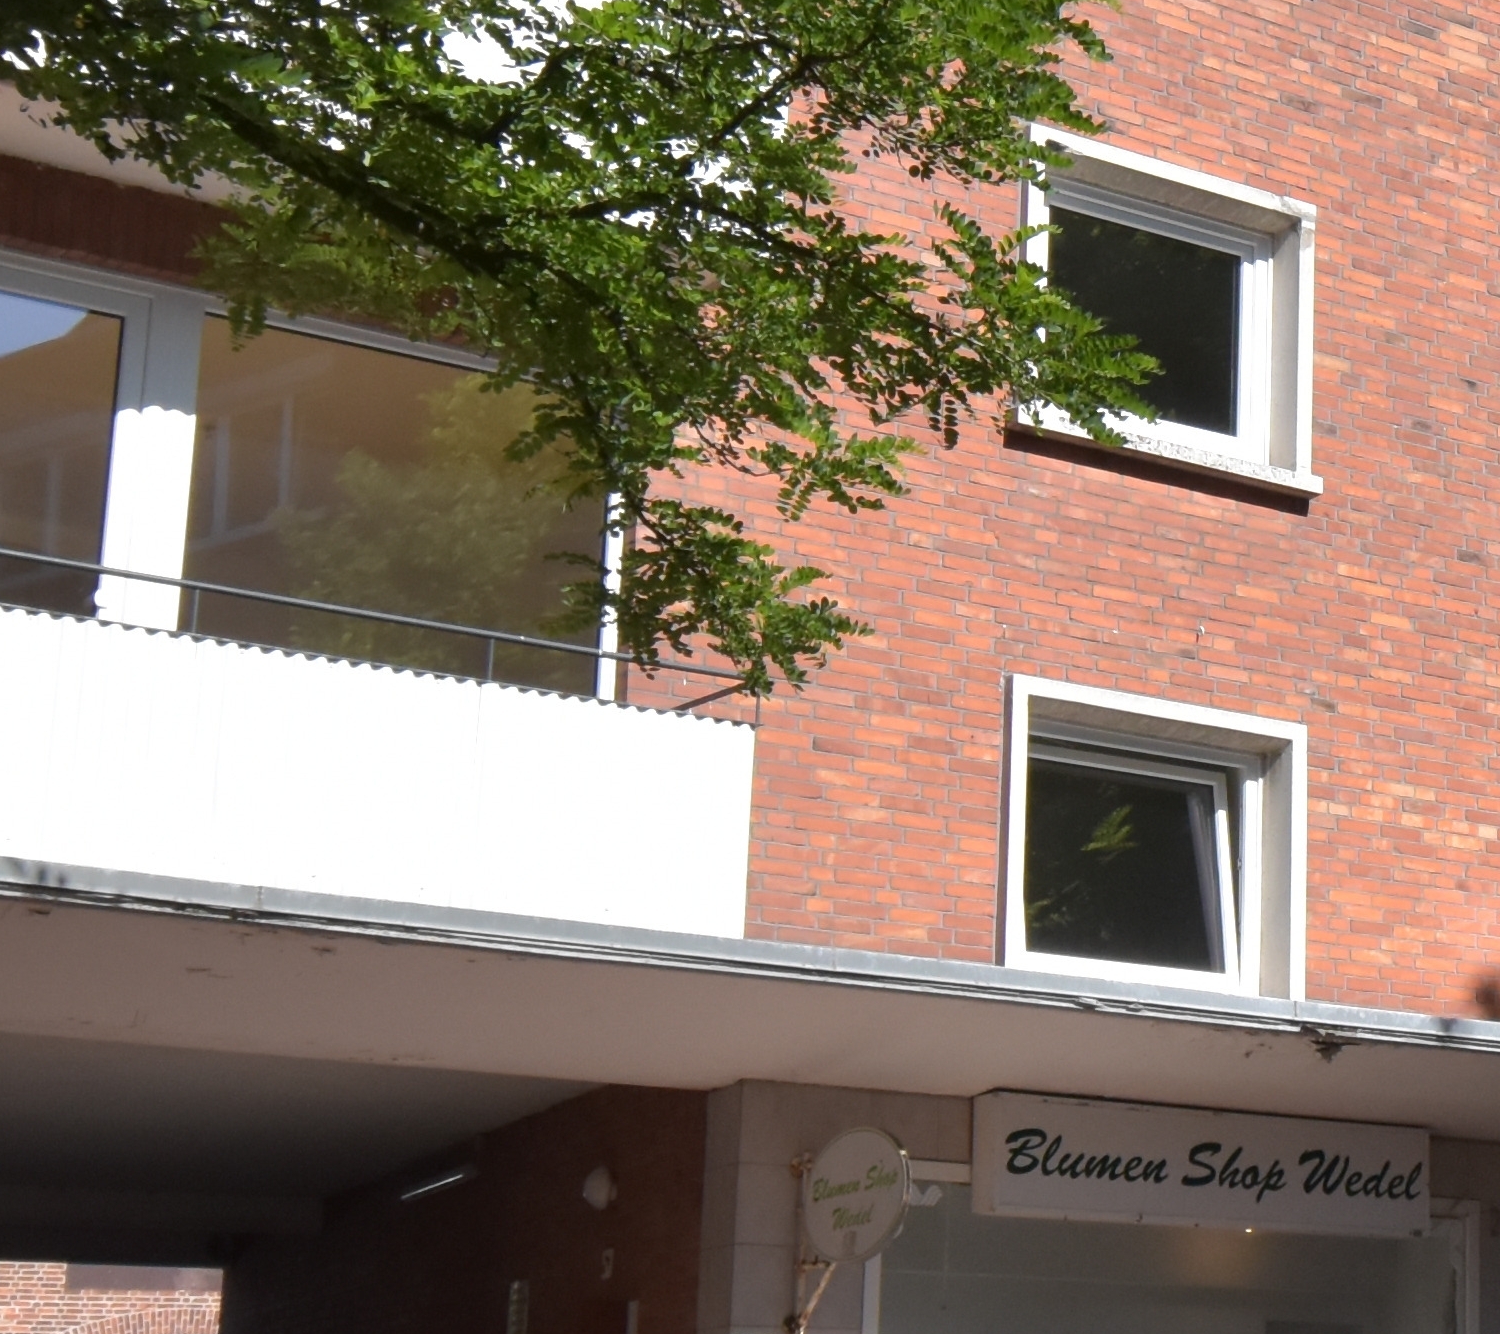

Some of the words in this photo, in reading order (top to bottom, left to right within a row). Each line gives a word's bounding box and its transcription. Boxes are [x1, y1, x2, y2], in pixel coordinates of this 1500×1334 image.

[812, 1176, 861, 1203] Blumen
[864, 1163, 898, 1191] Shop
[1005, 1127, 1169, 1183] Blumen
[1181, 1142, 1288, 1202] Shop
[1298, 1149, 1423, 1201] Wedel
[832, 1203, 875, 1231] Wedel
